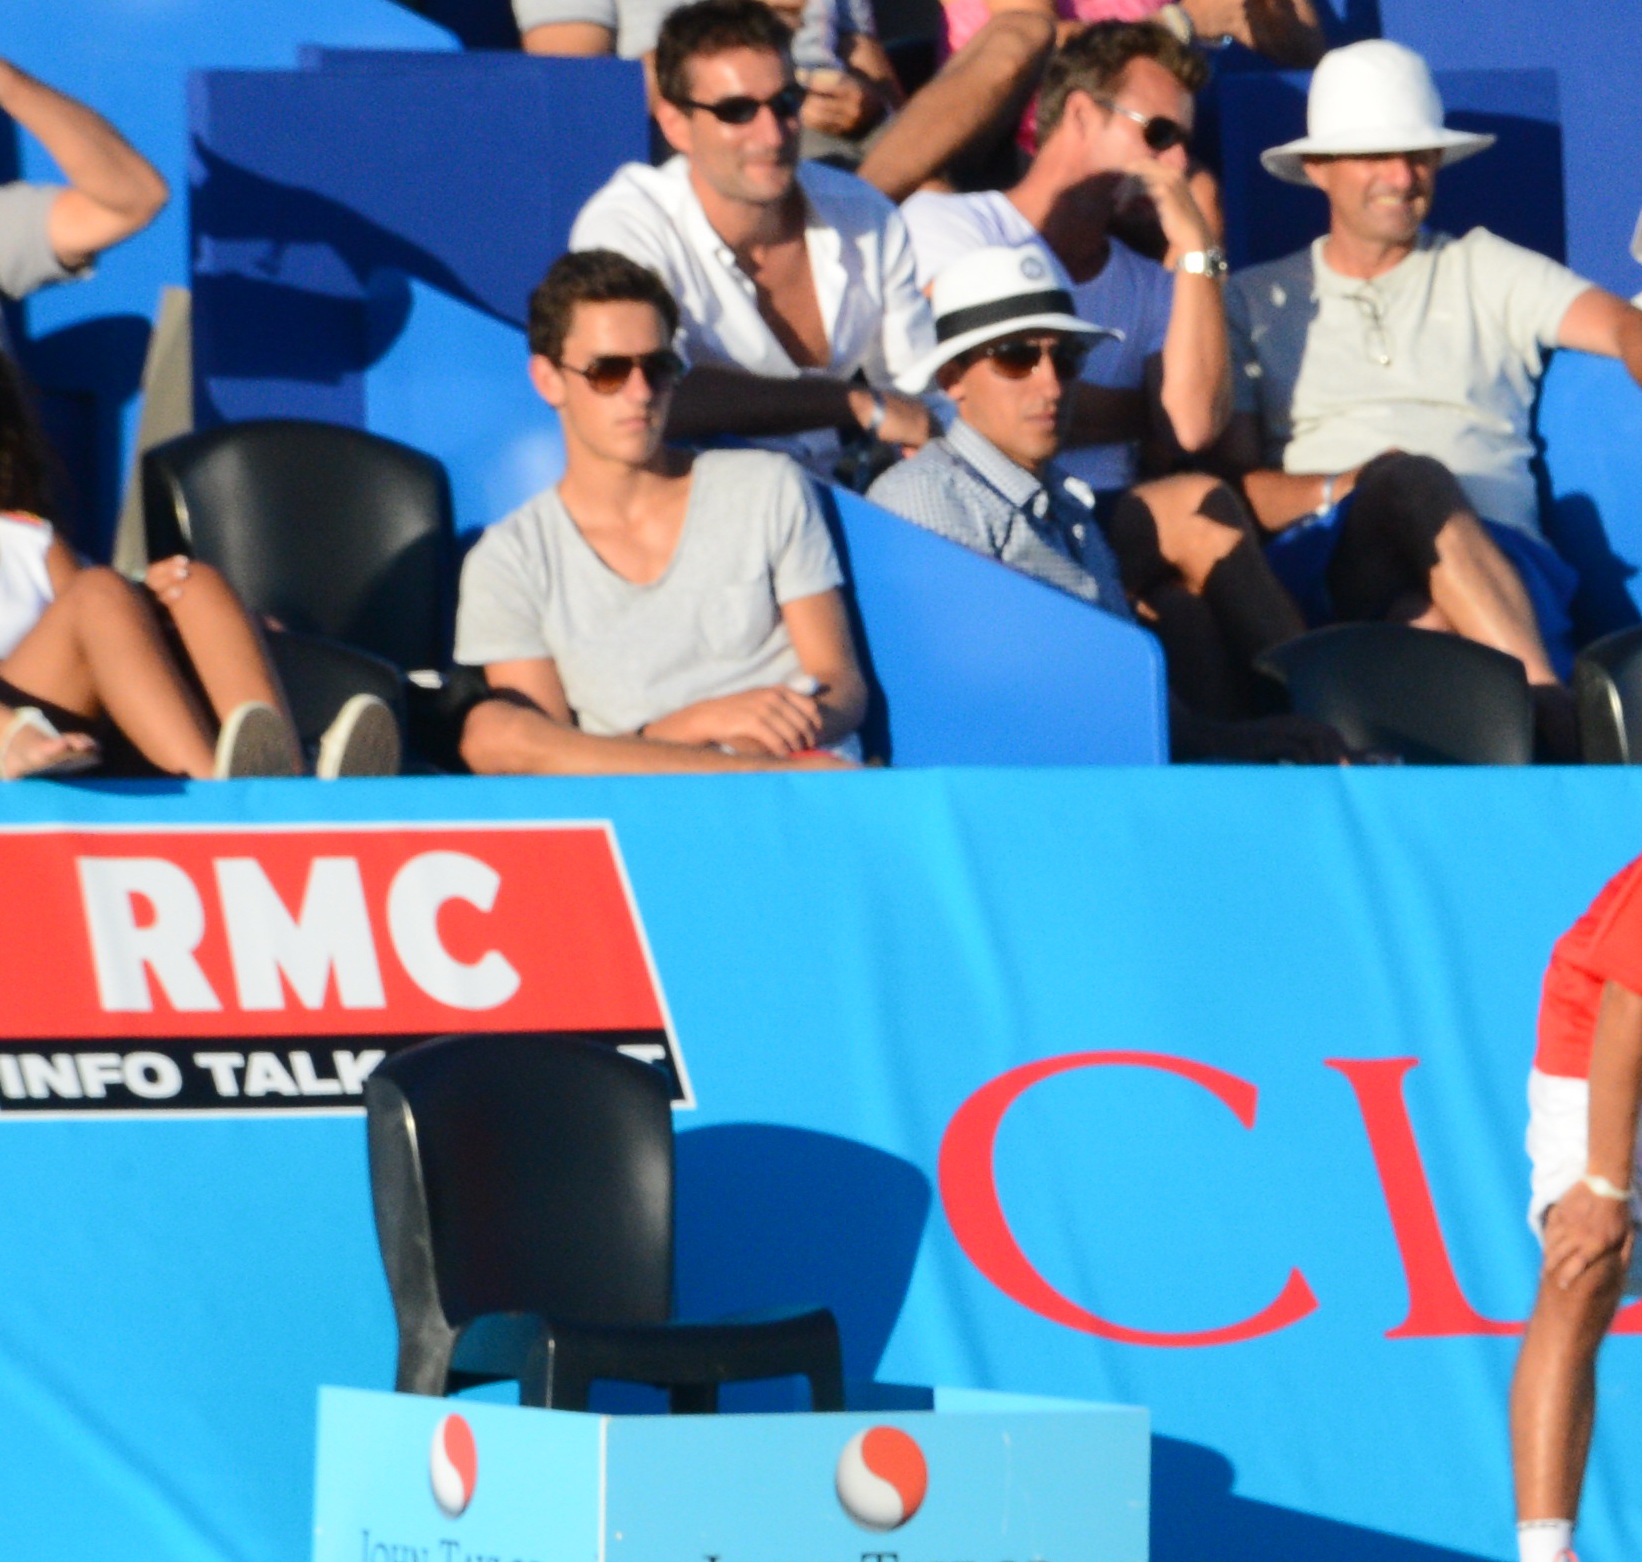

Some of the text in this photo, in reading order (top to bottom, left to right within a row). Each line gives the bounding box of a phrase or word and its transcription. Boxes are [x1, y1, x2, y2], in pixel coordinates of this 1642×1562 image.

[76, 850, 521, 1012] RMC
[0, 1050, 387, 1099] INFO TALK
